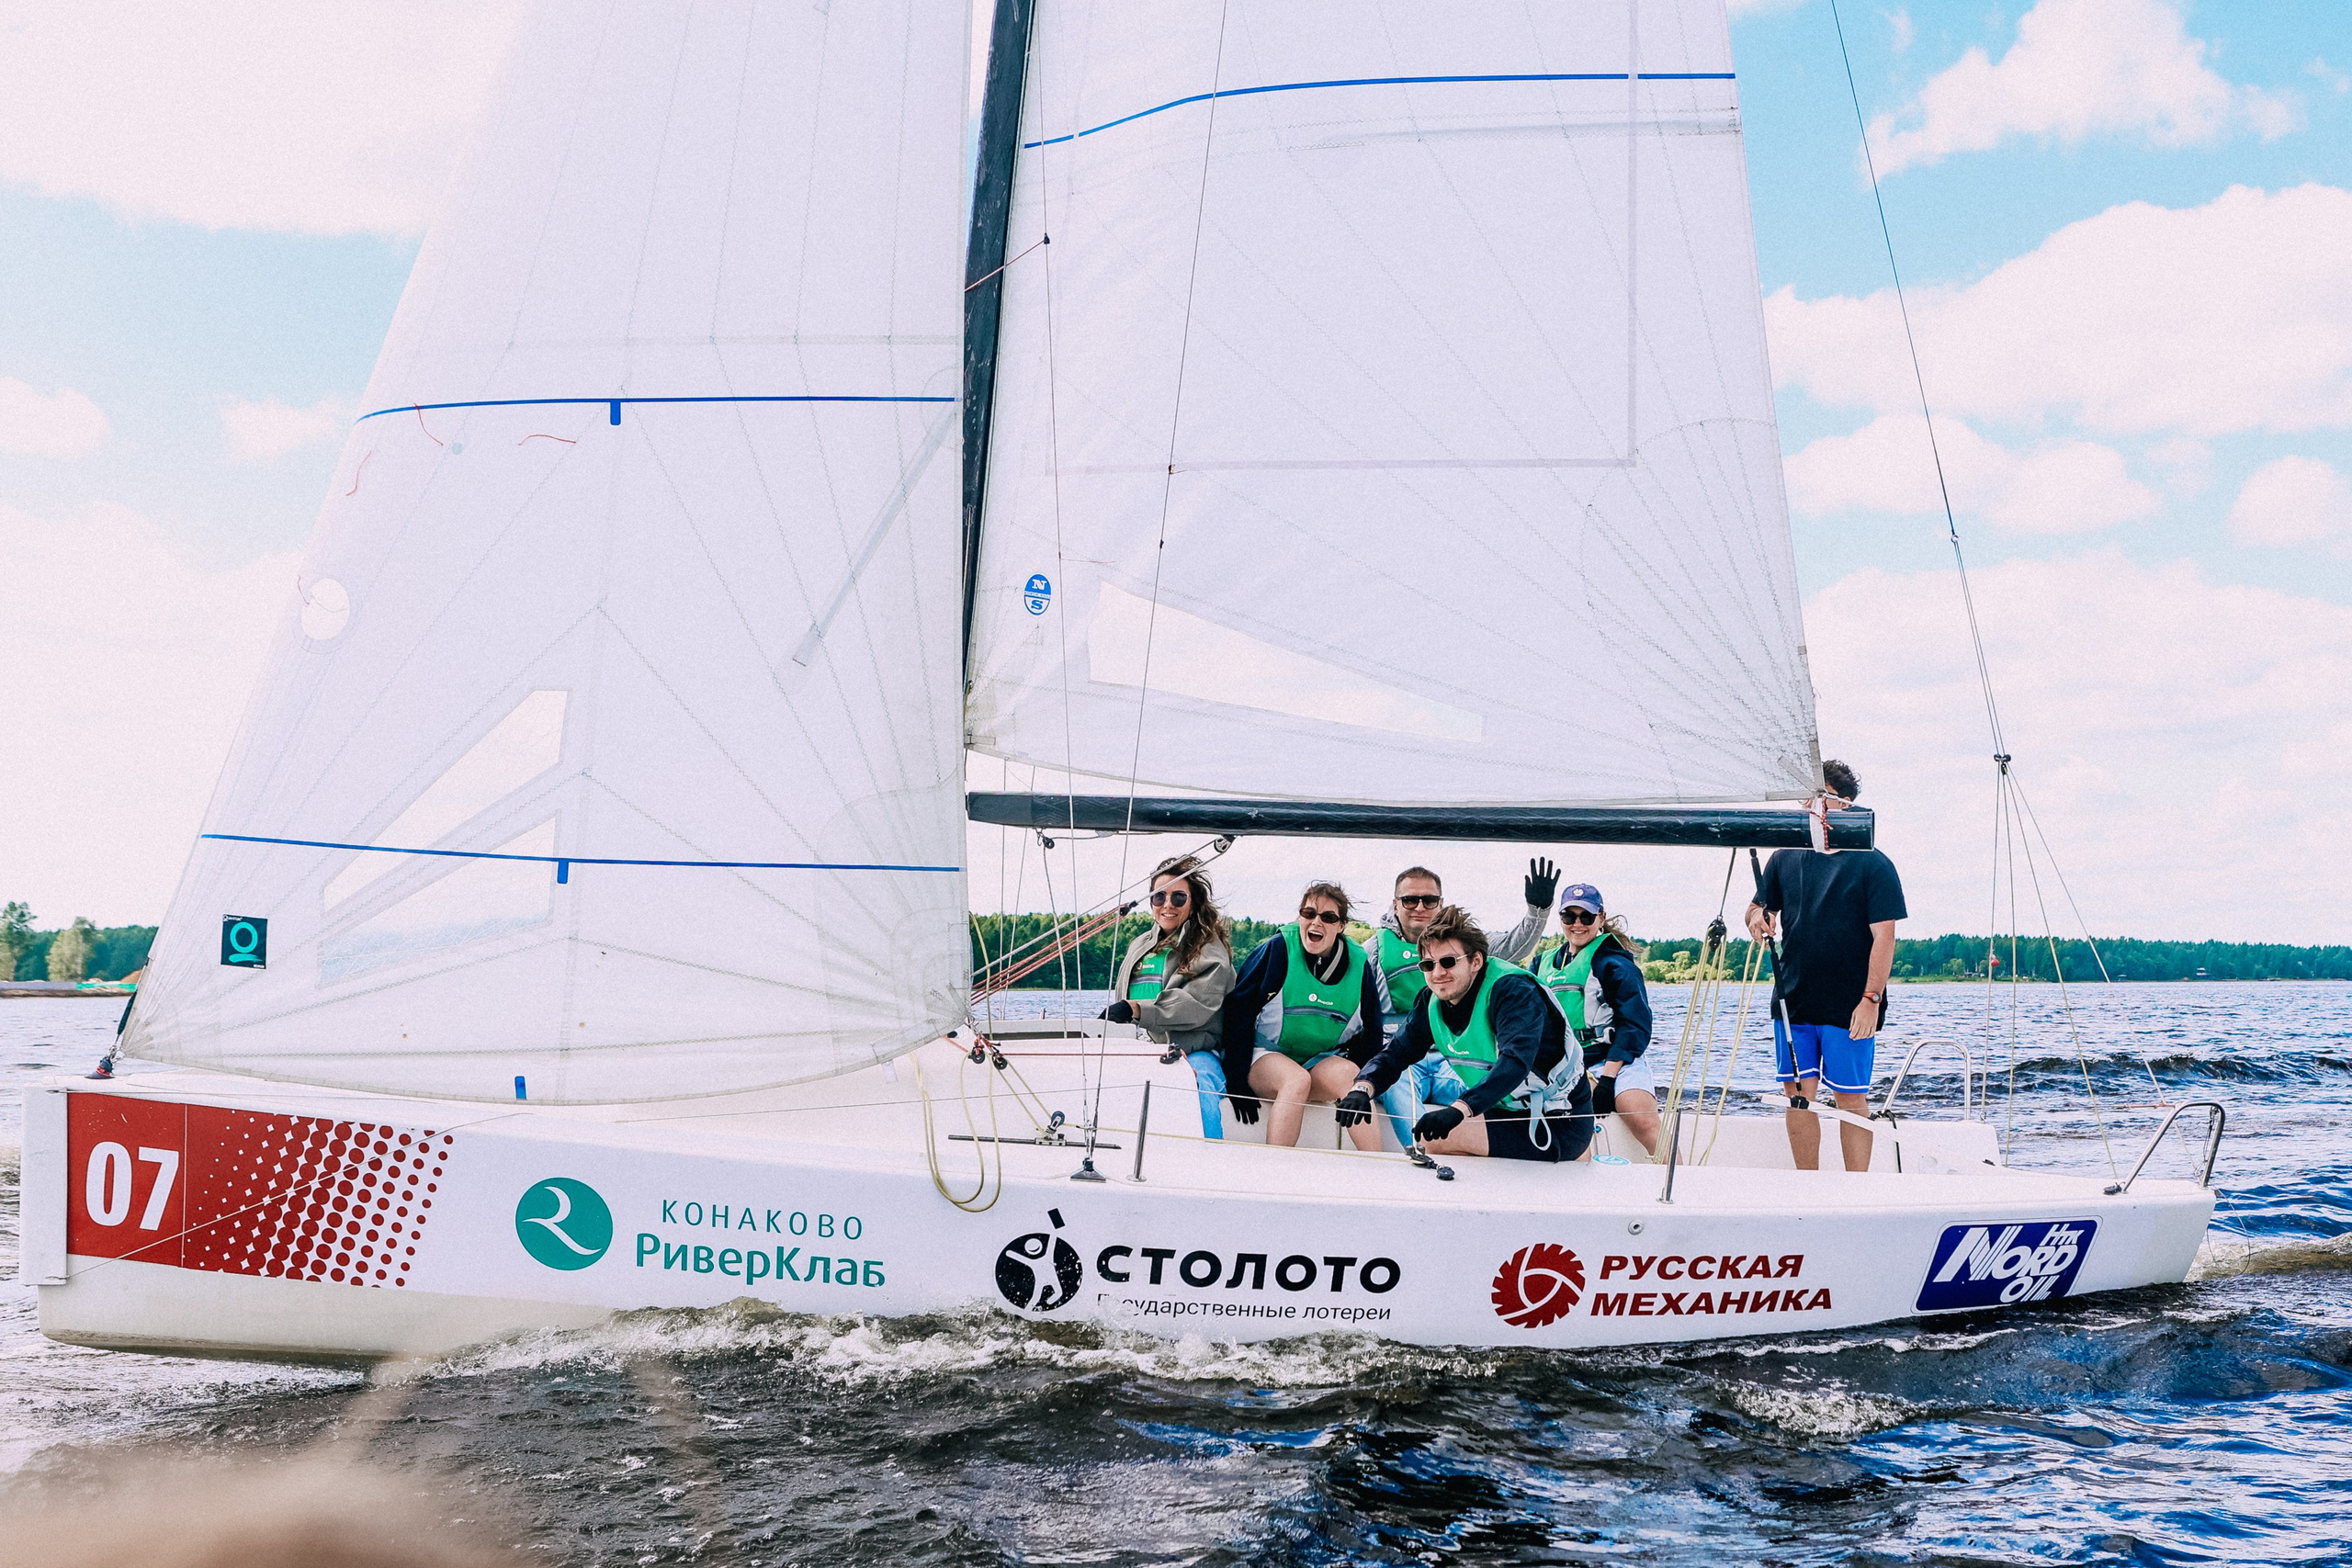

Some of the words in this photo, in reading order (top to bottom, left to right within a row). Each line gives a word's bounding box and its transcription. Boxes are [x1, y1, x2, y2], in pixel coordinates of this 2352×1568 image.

[85, 1140, 181, 1232] 07
[661, 1198, 864, 1241] КОНАКОВО
[635, 1232, 887, 1288] РиверКлаб
[1095, 1244, 1402, 1294] СТОЛОТО
[1599, 1255, 1804, 1280] РУССКАЯ
[1301, 1305, 1392, 1324] лотереи
[1590, 1288, 1832, 1316] МЕХАНИКА
